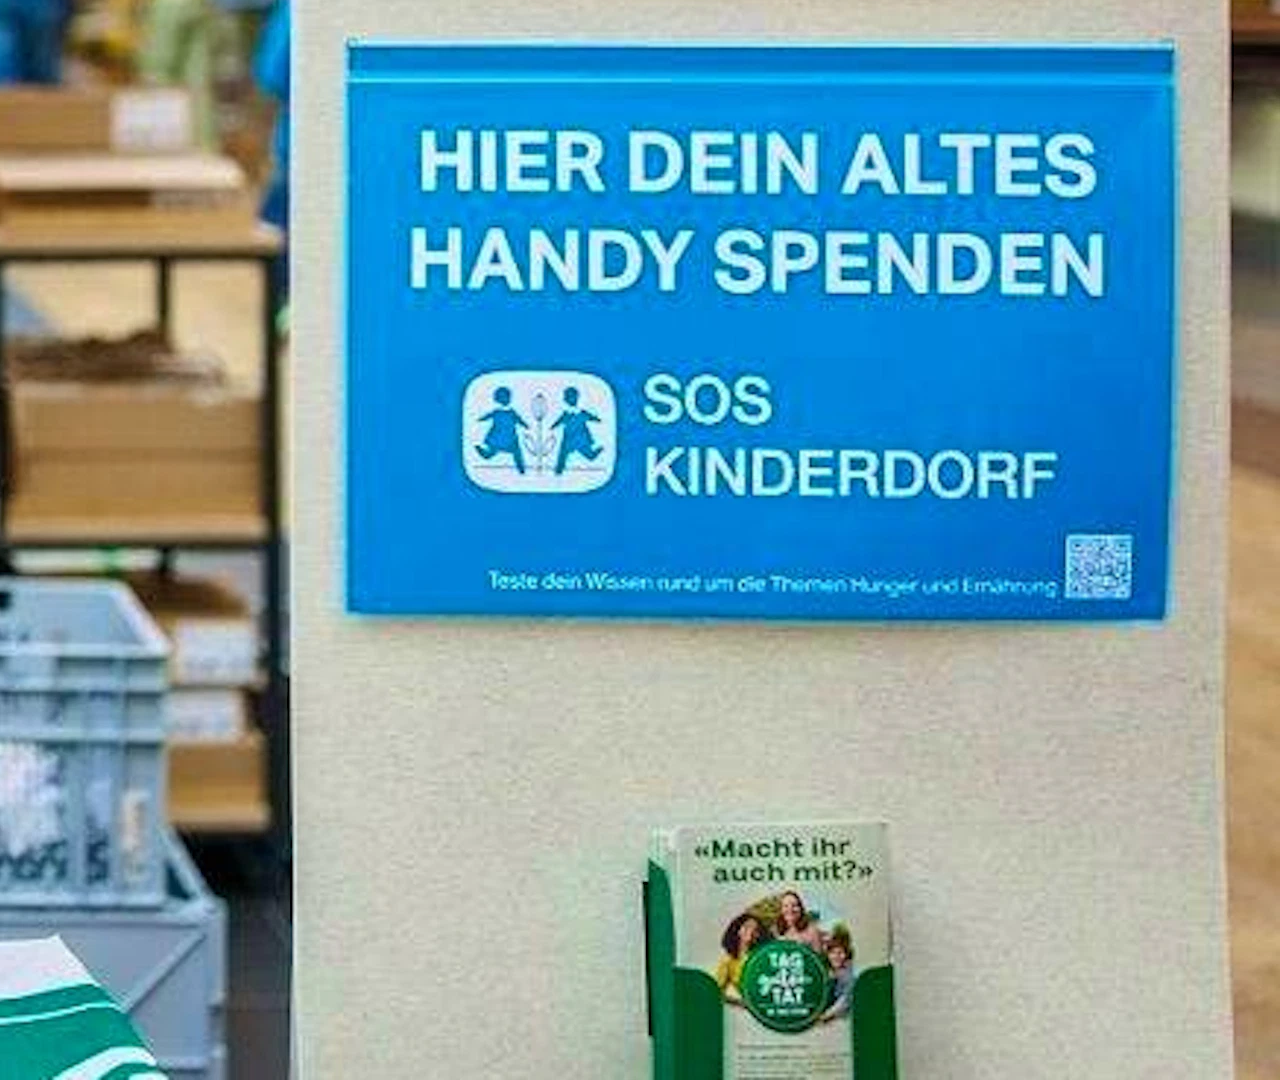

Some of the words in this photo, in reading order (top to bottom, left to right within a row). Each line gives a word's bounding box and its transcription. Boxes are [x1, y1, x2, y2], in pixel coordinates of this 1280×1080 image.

[420, 130, 605, 193] HIER
[629, 130, 818, 195] DEIN
[842, 133, 1097, 198] ALTES
[411, 227, 694, 291] HANDY
[714, 229, 1103, 297] SPENDEN
[643, 373, 773, 426] SOS
[646, 446, 1057, 500] KINDERDORF
[488, 570, 538, 590] Teste
[541, 570, 582, 591] dein
[586, 571, 654, 592] Wissen
[656, 575, 701, 593] rund
[705, 577, 734, 593] um
[737, 575, 767, 593] die
[770, 574, 847, 595] Themen
[850, 576, 919, 599] Hunger
[921, 576, 960, 596] und
[694, 837, 804, 858] «Macht
[811, 837, 851, 857] ihr
[713, 863, 785, 884] auch
[793, 859, 874, 882] mit?»
